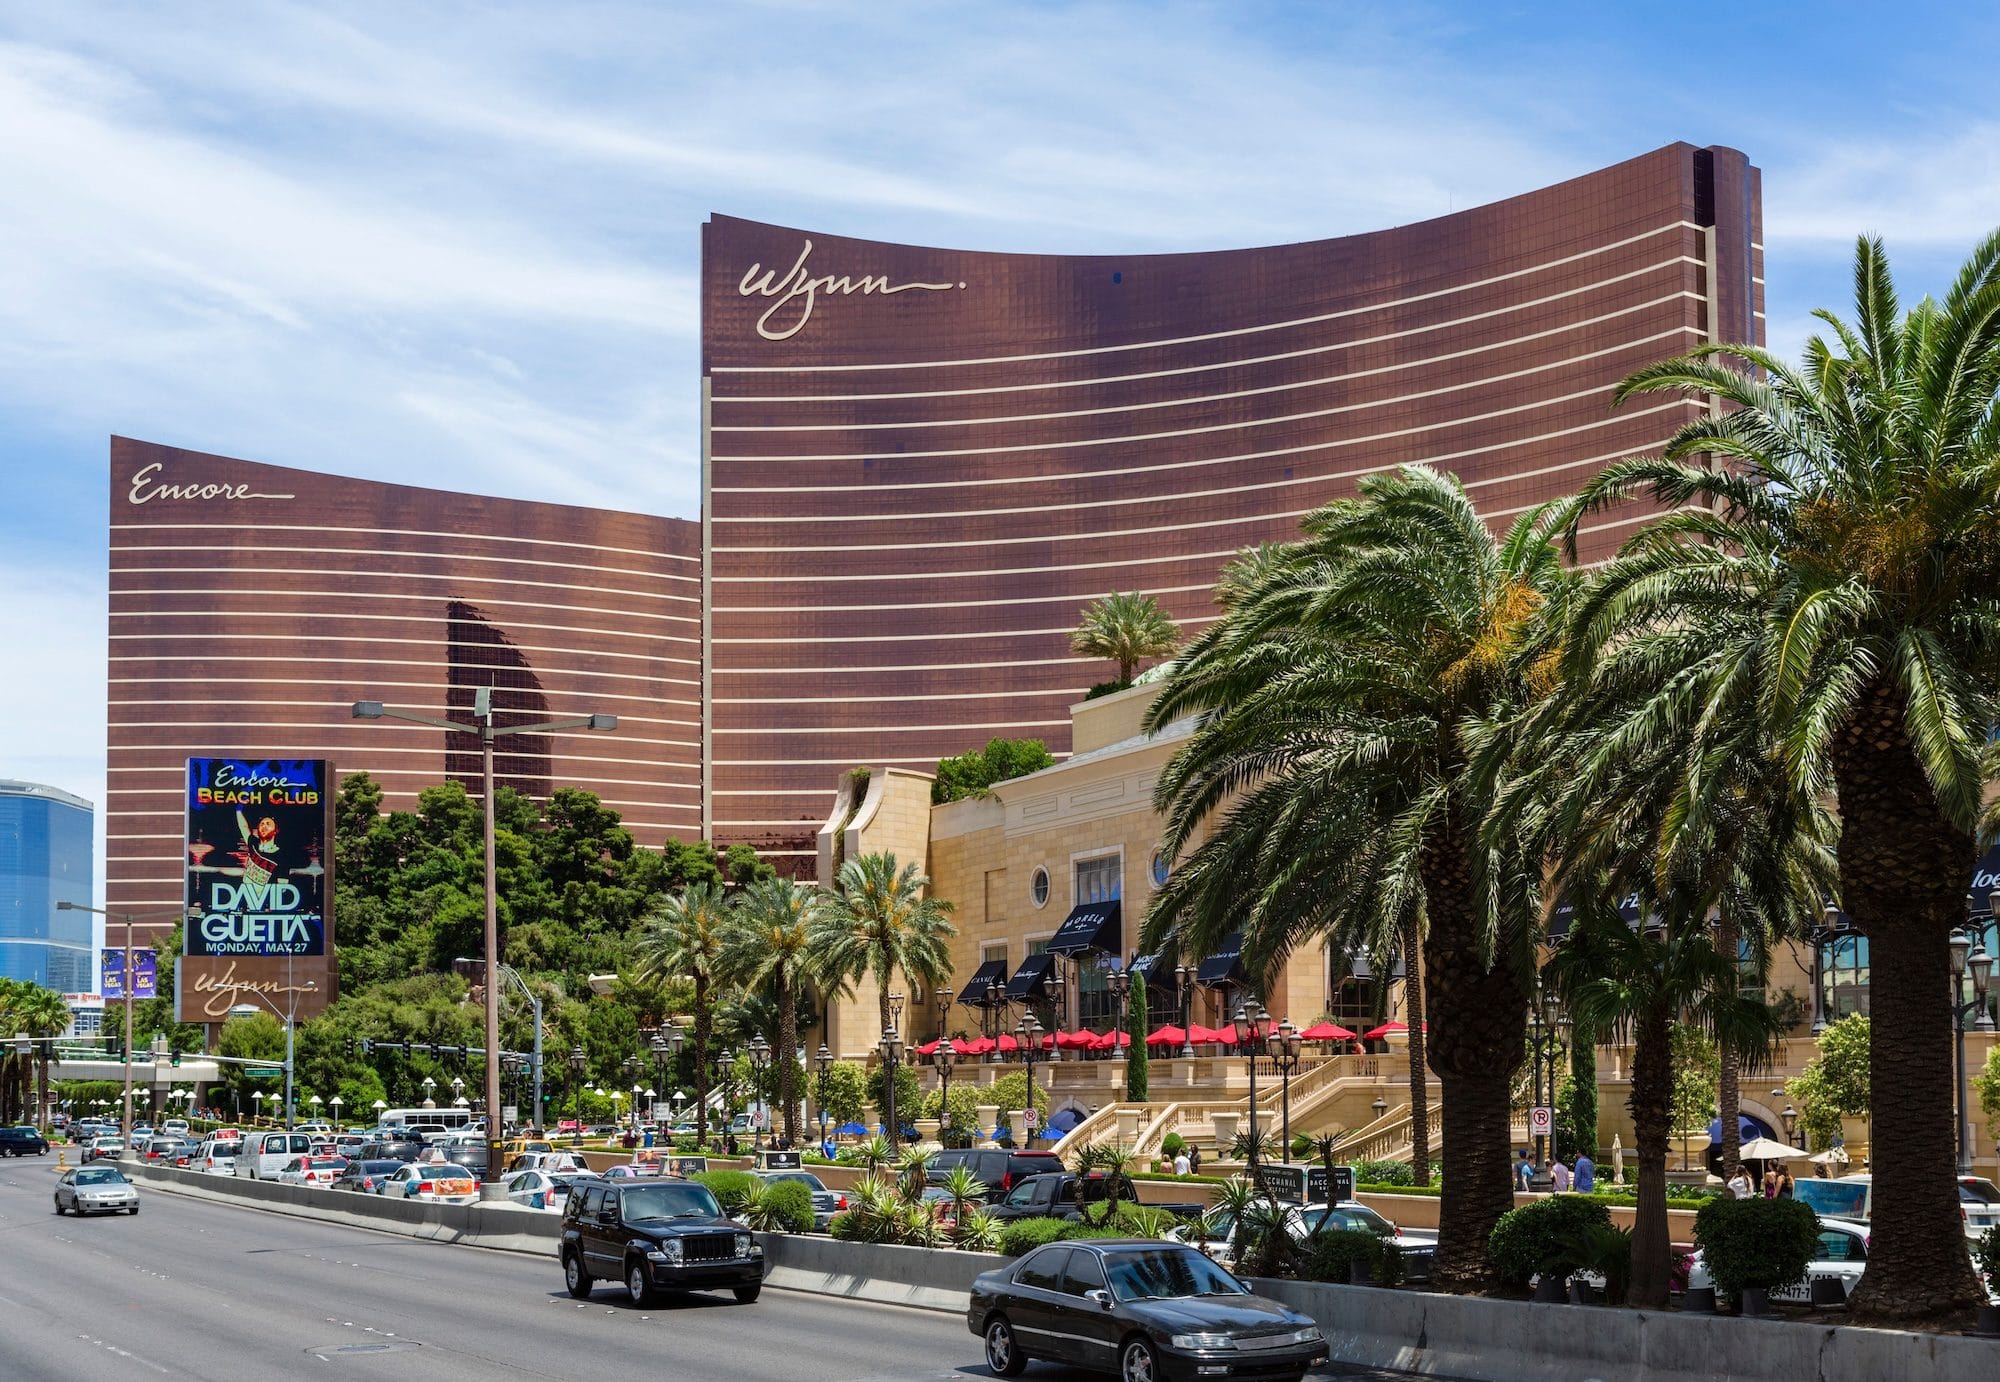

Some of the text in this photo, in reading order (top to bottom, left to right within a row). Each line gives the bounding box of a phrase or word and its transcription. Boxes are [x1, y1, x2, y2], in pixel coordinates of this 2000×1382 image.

[128, 462, 296, 505] Encore
[214, 764, 308, 788] Encore
[197, 787, 319, 805] BEACH CLUB
[211, 882, 300, 911] DAVID
[200, 913, 311, 942] GUETTA
[205, 942, 262, 954] MONDAY,
[294, 942, 308, 953] 27
